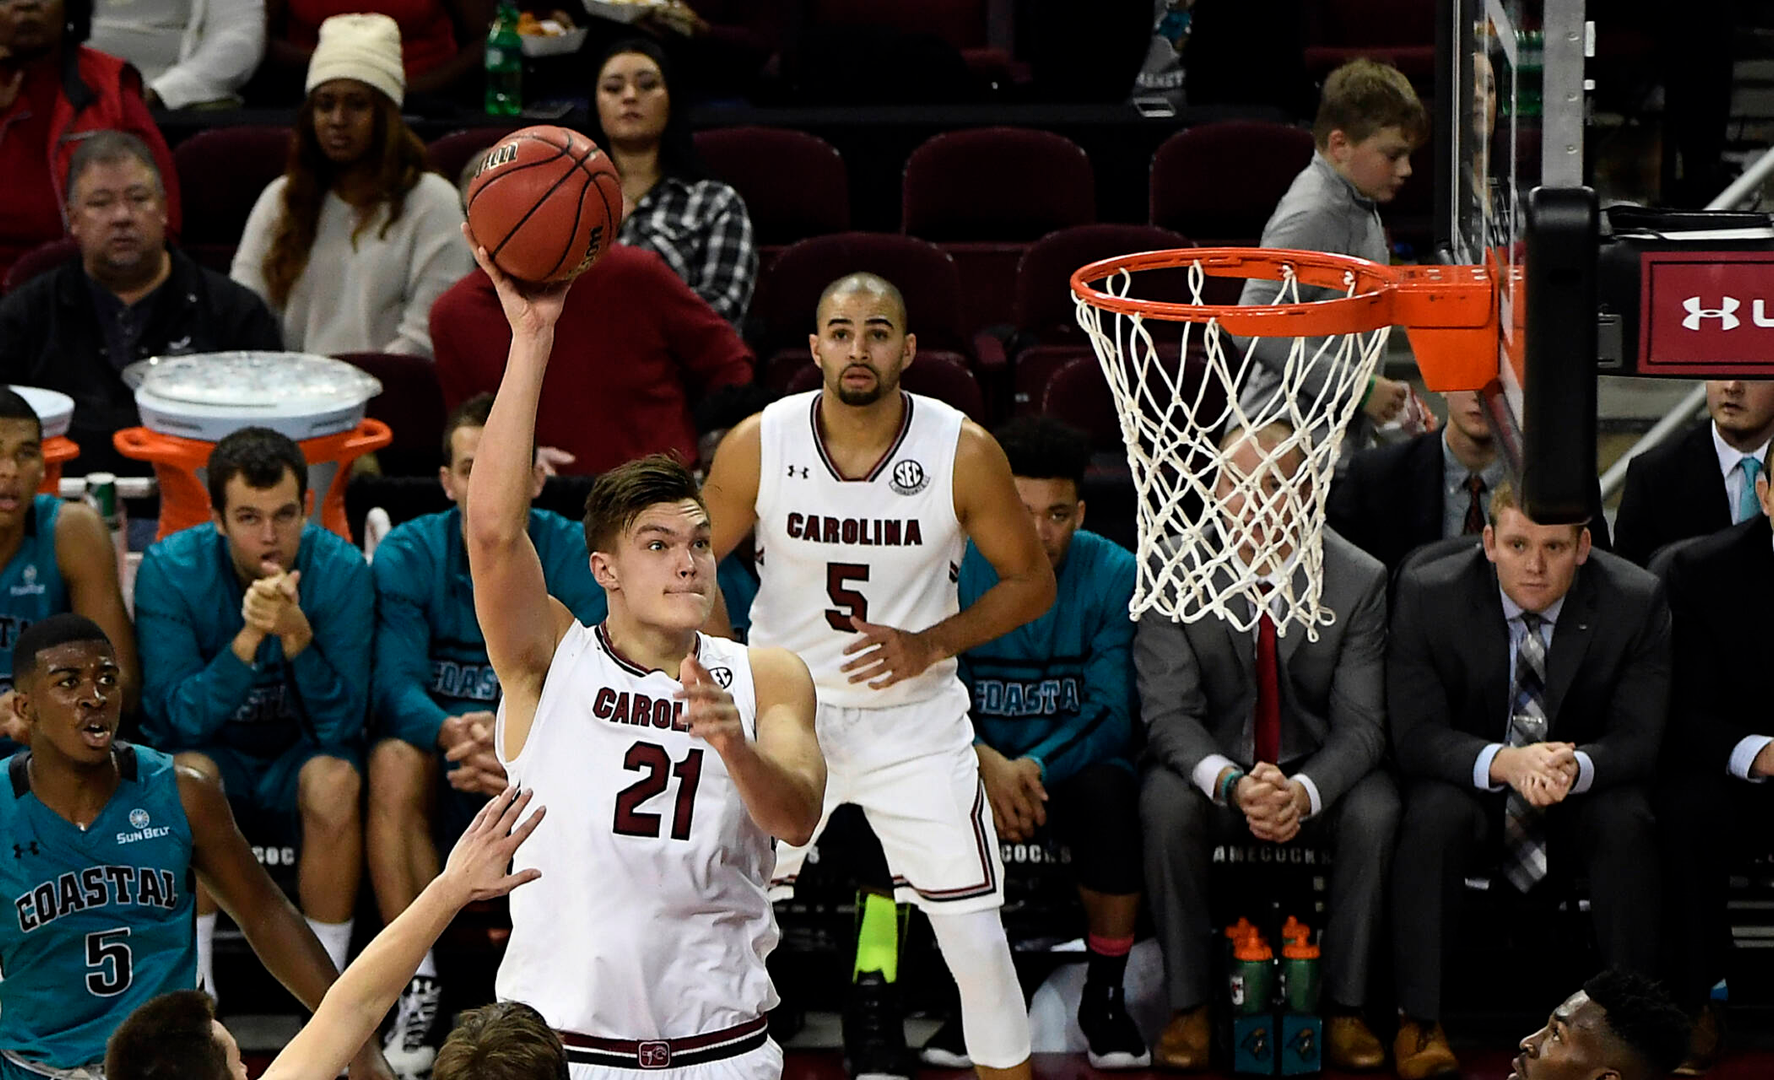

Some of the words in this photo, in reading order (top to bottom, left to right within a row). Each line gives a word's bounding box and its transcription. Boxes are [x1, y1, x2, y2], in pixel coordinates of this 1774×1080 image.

[895, 461, 921, 487] SEC
[787, 512, 923, 546] CAROLINA
[825, 562, 870, 634] 5
[709, 666, 733, 688] EC
[593, 687, 692, 733] CAROL
[613, 741, 704, 841] 21
[15, 865, 178, 934] COASTAL
[86, 927, 133, 998] 5
